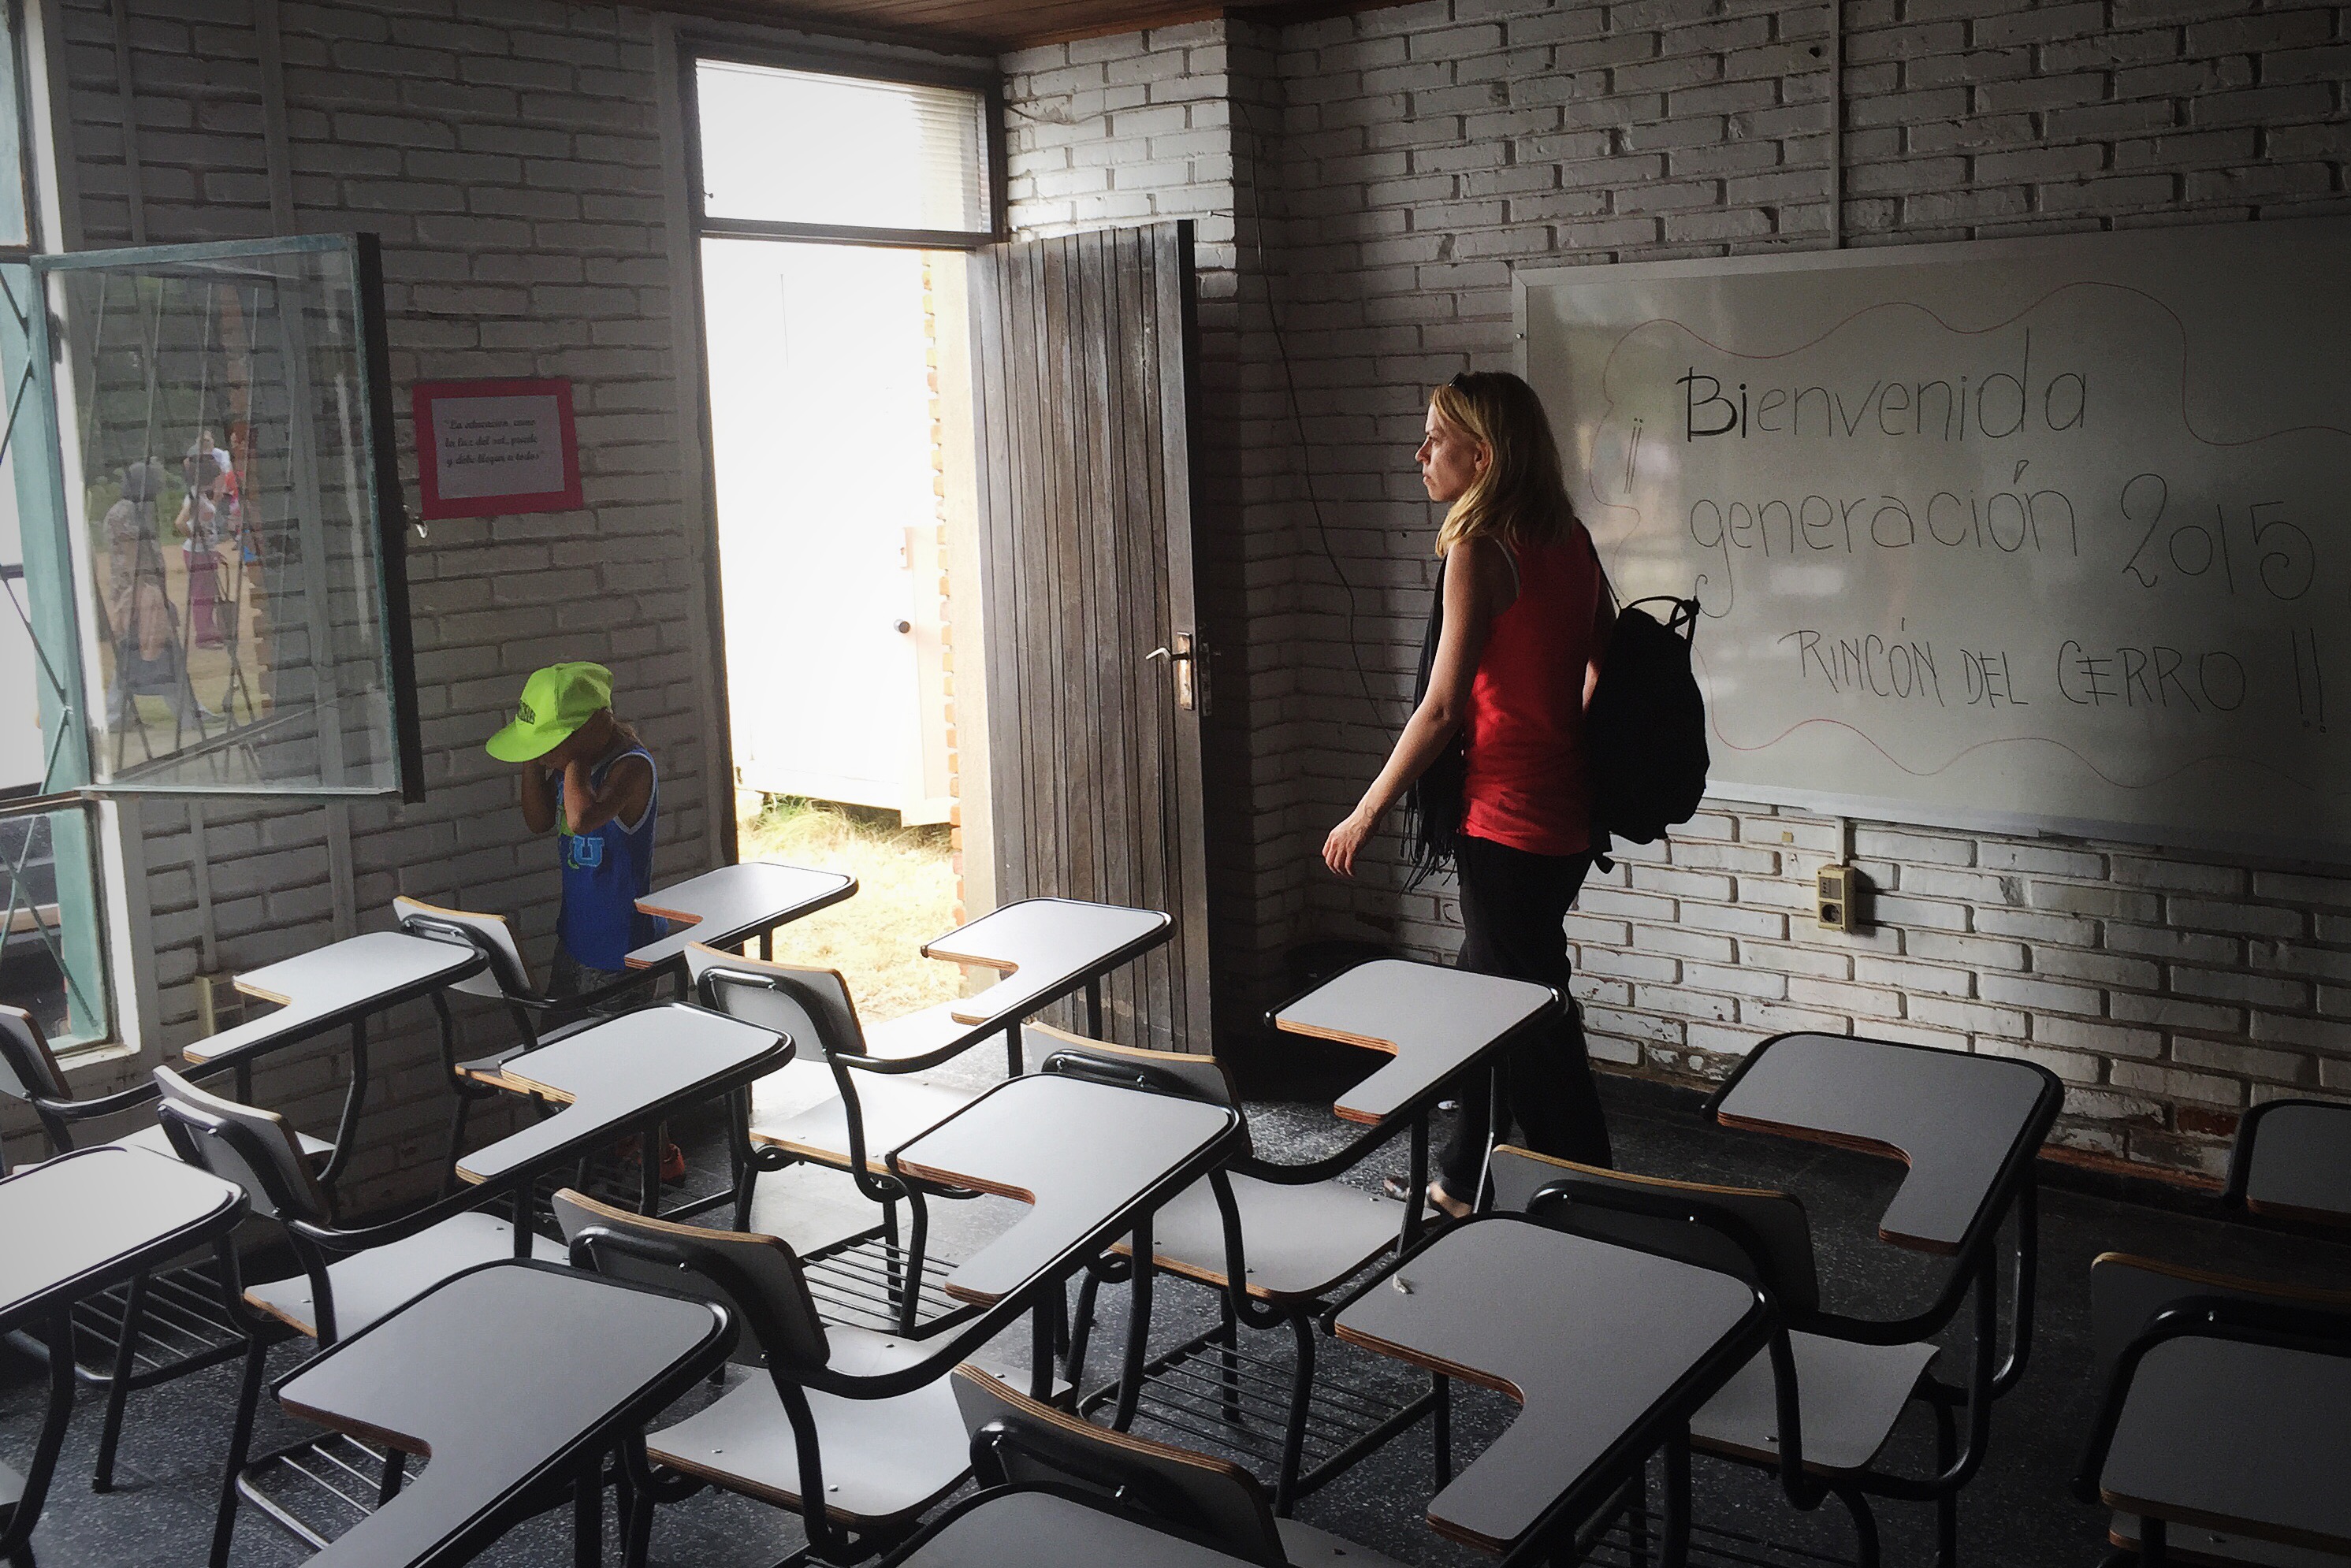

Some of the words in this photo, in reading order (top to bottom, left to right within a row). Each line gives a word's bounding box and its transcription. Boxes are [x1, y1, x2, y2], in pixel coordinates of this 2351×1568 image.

[1676, 325, 2086, 444] Bienvenida
[1690, 459, 2078, 619] generación
[2120, 473, 2316, 601] 2015
[1777, 616, 1945, 708] RINCÓN
[1960, 648, 2029, 708] DEL
[2057, 639, 2246, 713] CERRO
[573, 835, 605, 868] U
